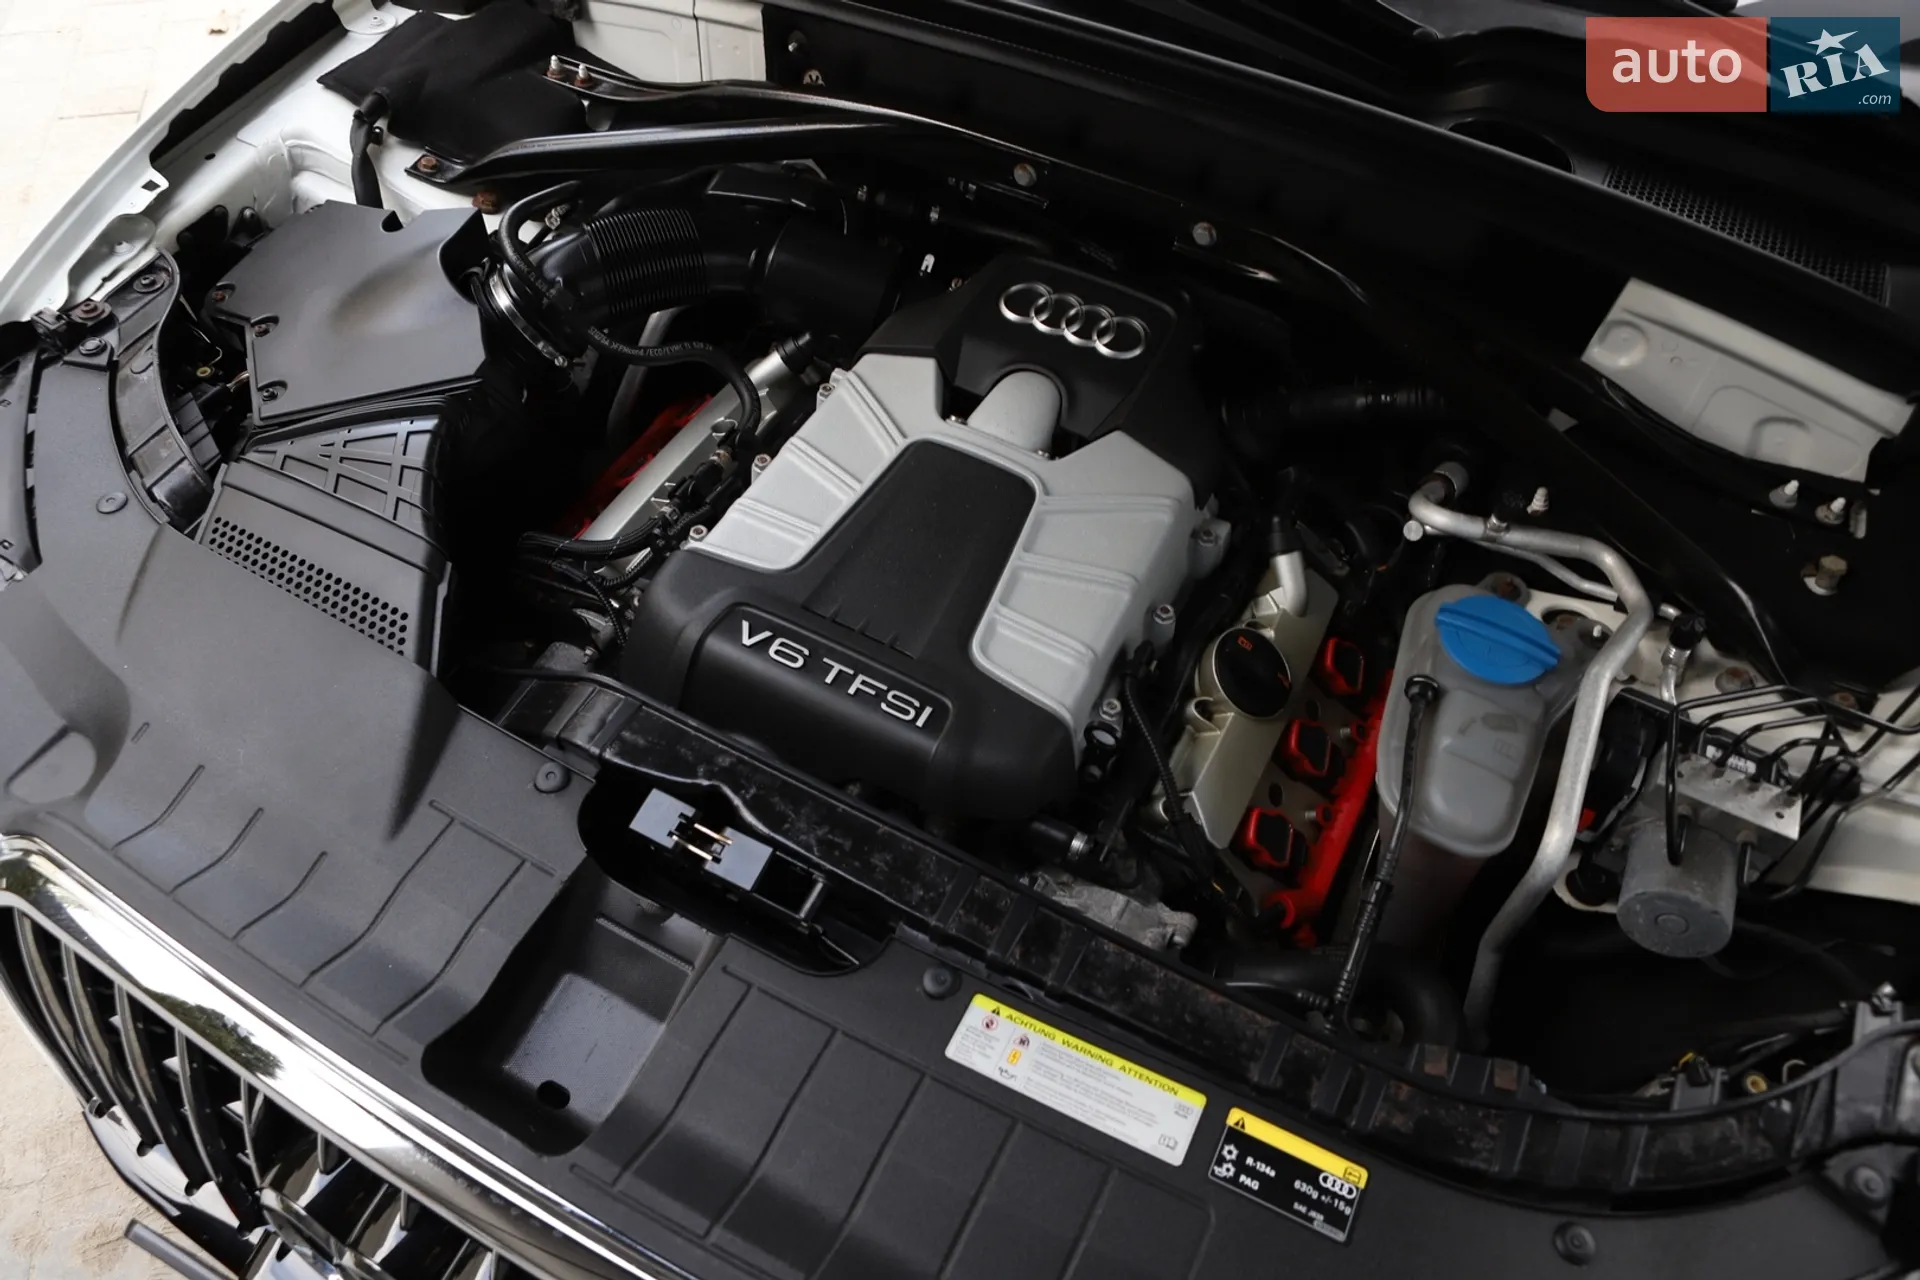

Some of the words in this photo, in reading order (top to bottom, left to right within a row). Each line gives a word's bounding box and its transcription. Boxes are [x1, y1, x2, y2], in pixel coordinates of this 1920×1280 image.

[741, 619, 810, 669] V6
[822, 656, 933, 728] TFSI
[1005, 1013, 1056, 1041] ACHTUNG
[1061, 1038, 1114, 1067] WARNING
[1118, 1065, 1180, 1096] ATTENTION
[1238, 1173, 1260, 1191] PAG
[1245, 1155, 1276, 1178] R-134a
